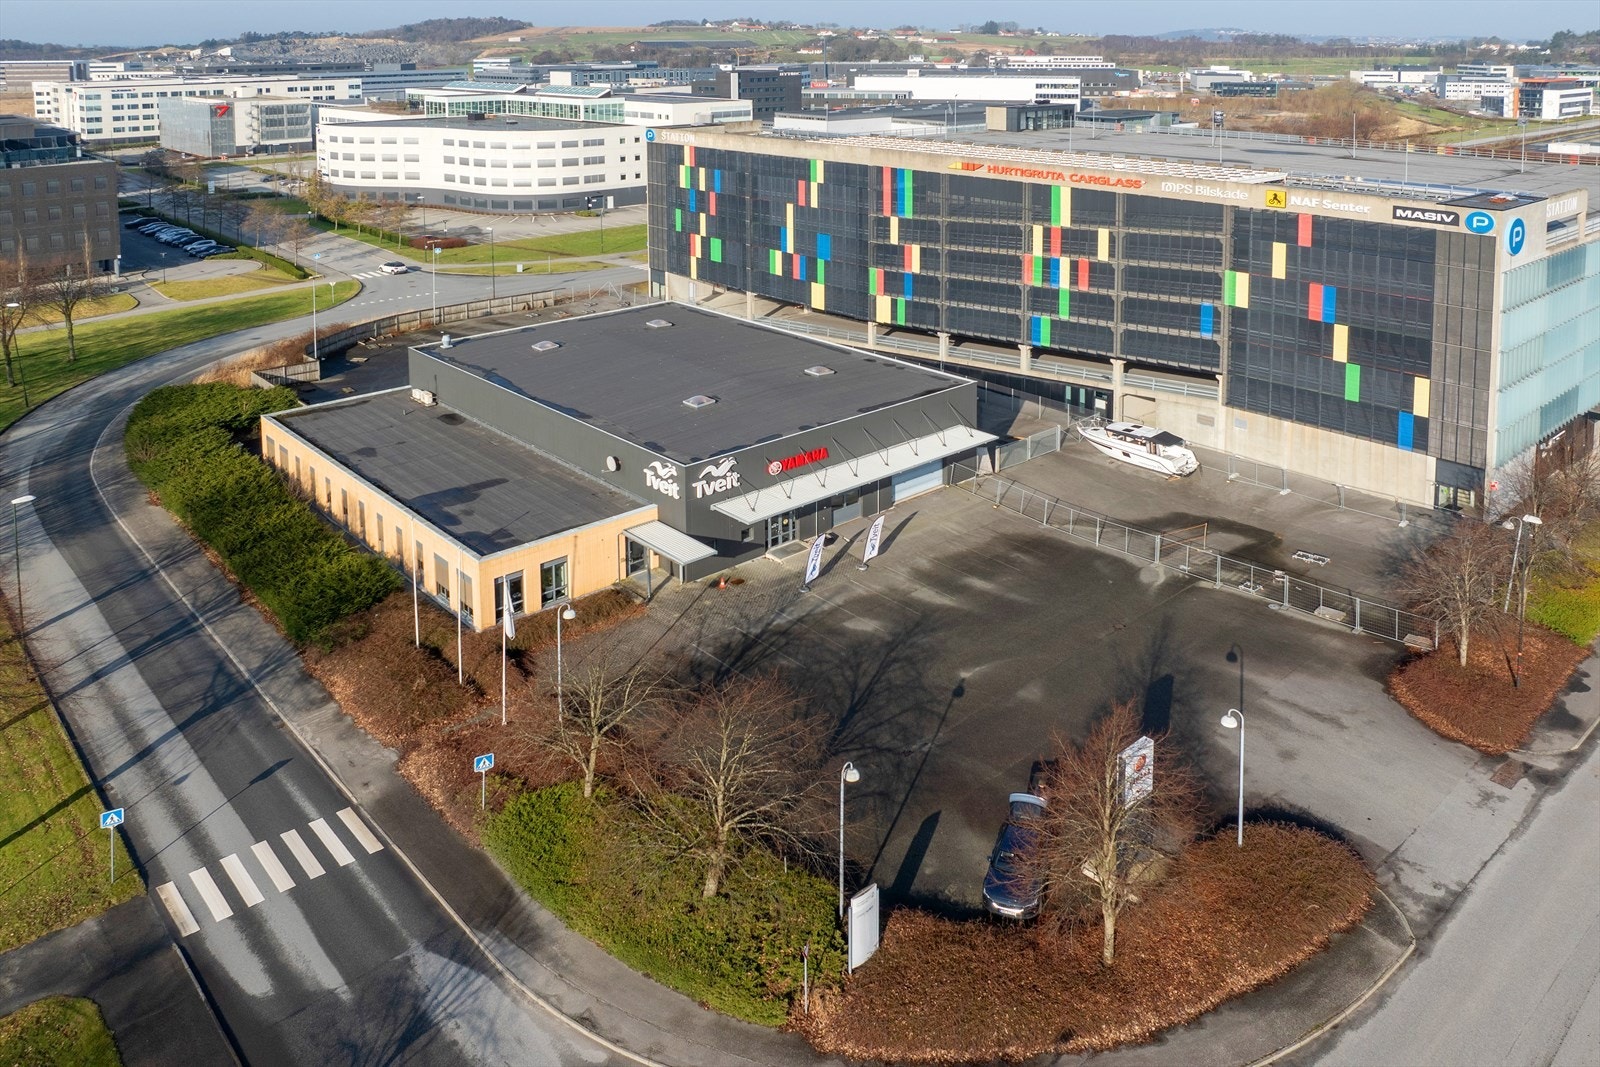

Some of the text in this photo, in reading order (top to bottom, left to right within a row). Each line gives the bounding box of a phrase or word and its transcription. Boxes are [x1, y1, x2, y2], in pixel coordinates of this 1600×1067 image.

[661, 131, 695, 143] STATION
[987, 164, 1142, 189] HURTIGRUTA CARGLASS
[1194, 184, 1249, 201] Bilskade
[1290, 195, 1371, 214] NAF Senter
[1546, 196, 1578, 218] STATION
[1395, 209, 1455, 223] MASIV
[1472, 216, 1489, 228] P
[1513, 227, 1522, 248] P
[780, 447, 829, 472] YAMAHA
[643, 468, 680, 500] Tveit
[691, 471, 741, 499] Tveit
[870, 523, 880, 541] Tveit
